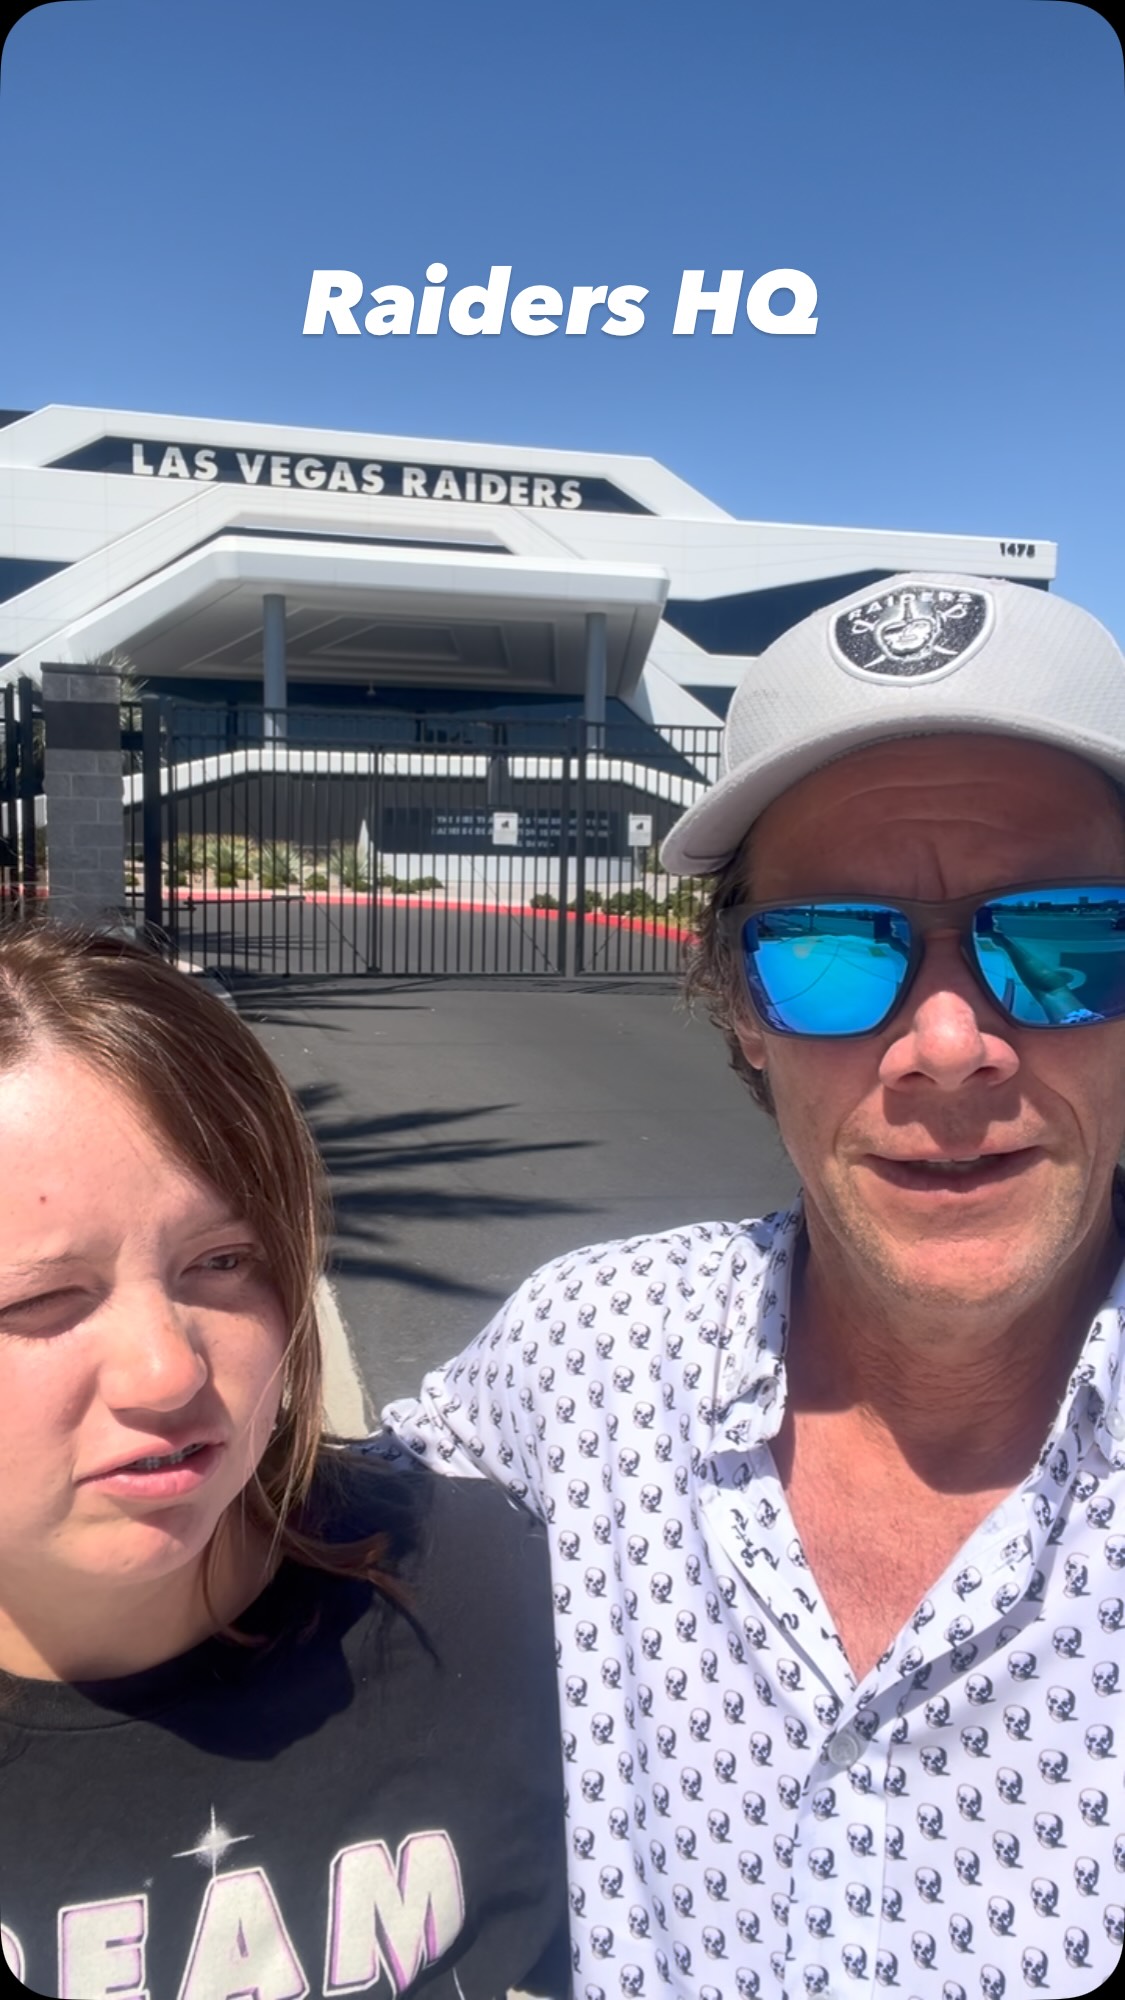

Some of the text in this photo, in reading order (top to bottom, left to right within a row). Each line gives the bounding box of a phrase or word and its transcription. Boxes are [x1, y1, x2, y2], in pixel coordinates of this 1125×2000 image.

[131, 443, 583, 509] LAS VEGAS RAIDERS
[848, 591, 973, 621] RAIDERS
[0, 1830, 465, 2000] EAM
